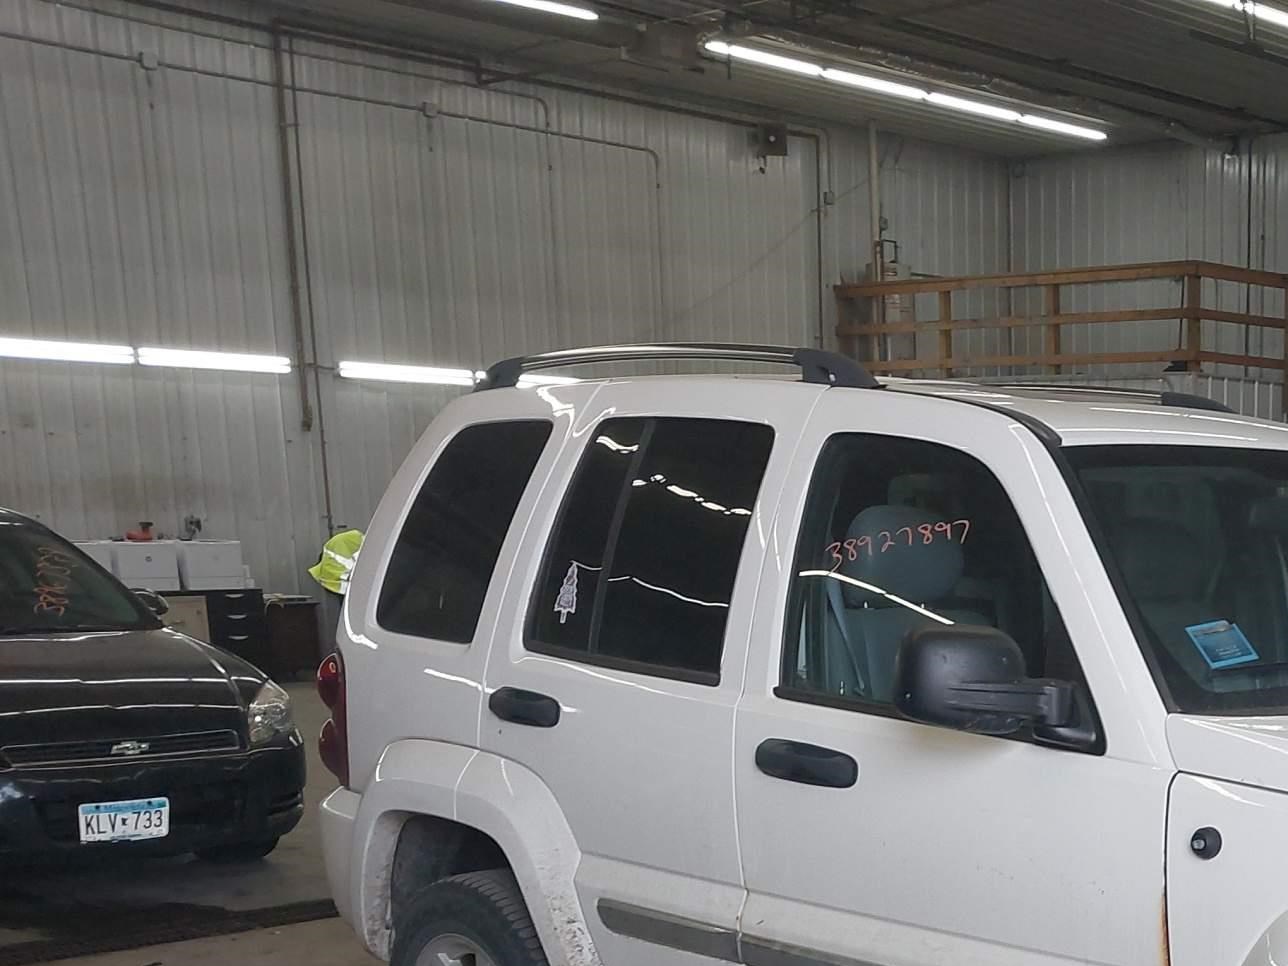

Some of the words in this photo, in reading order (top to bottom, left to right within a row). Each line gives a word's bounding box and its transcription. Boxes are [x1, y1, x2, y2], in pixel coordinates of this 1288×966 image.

[825, 519, 971, 572] 38927897
[84, 813, 118, 835] KLV
[132, 809, 163, 831] 733
